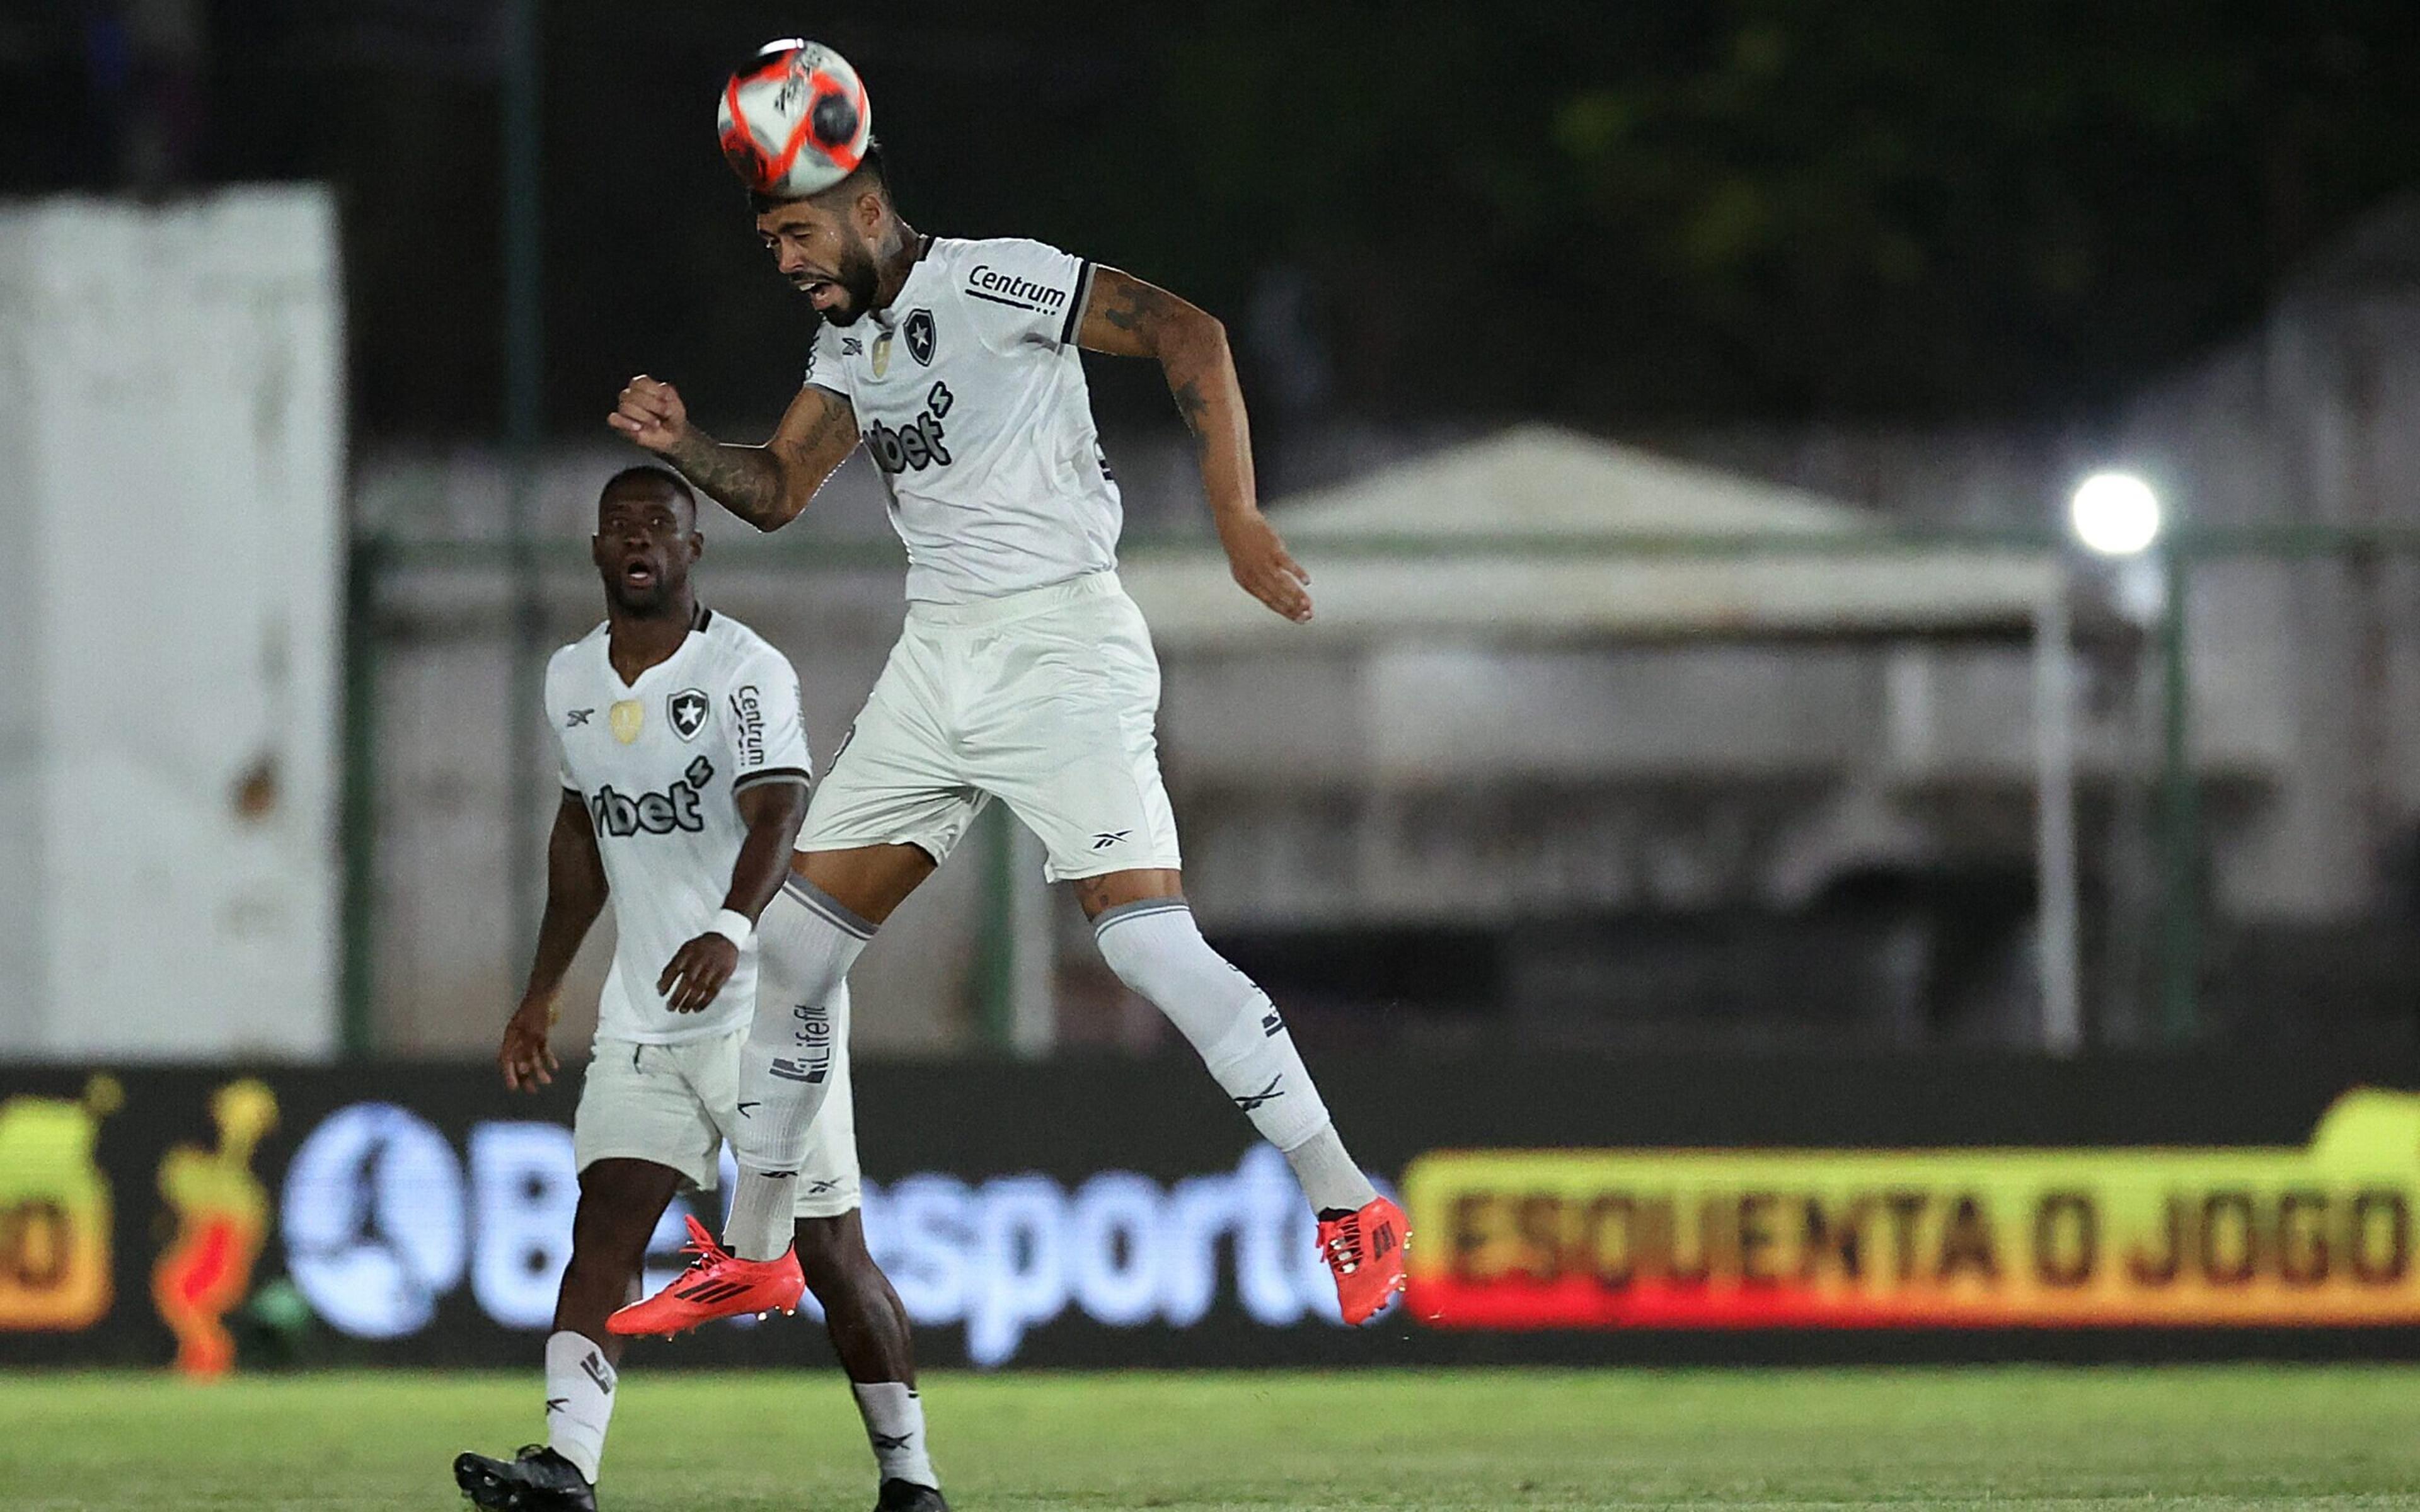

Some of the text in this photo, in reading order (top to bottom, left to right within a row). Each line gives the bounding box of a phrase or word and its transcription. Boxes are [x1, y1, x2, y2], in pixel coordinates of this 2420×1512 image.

[969, 265, 1066, 307] Centrum
[739, 685, 766, 765] Centrum
[793, 1004, 830, 1062] Lifefit
[470, 1120, 1407, 1364] Bsport
[1448, 1189, 2409, 1290] ESQUENTA O JOGO
